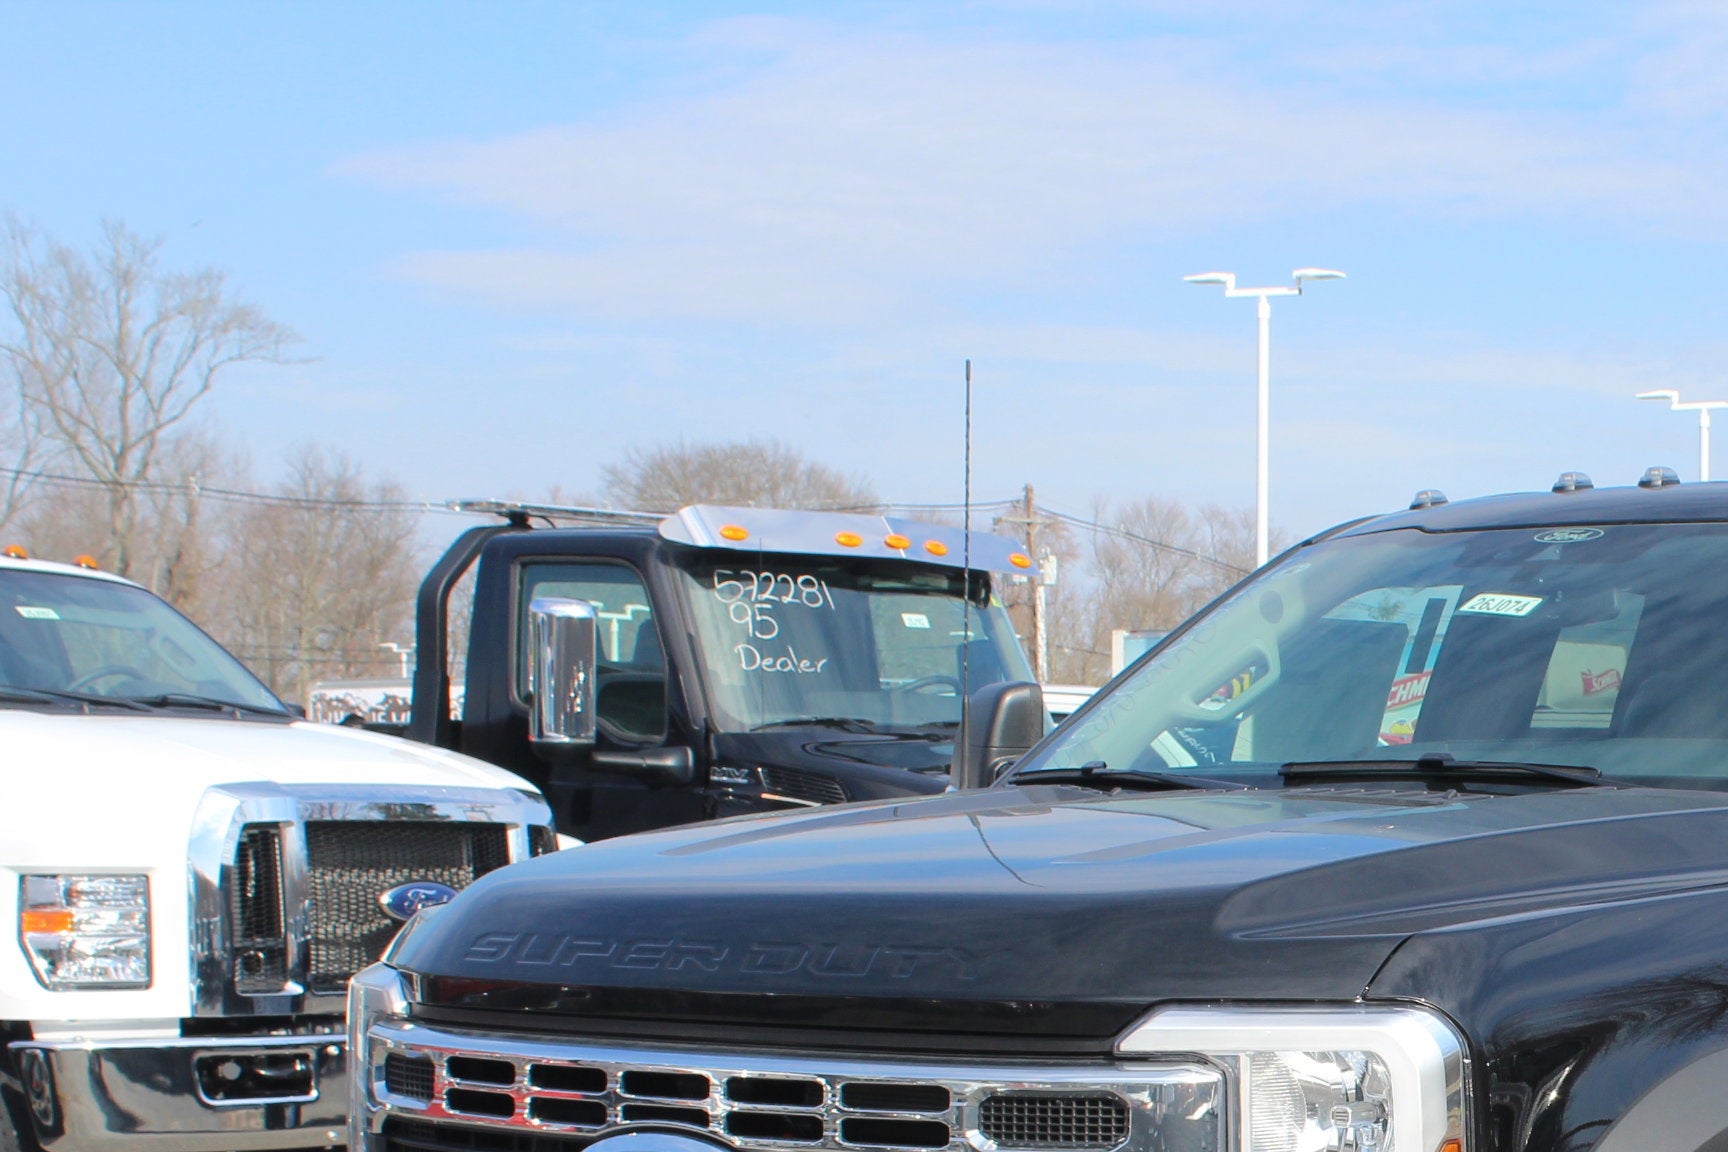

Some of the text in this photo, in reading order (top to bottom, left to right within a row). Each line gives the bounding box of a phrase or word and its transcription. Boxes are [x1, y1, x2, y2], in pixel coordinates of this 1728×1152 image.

[729, 601, 779, 639] 95
[1467, 597, 1532, 614] 26J074
[734, 643, 829, 673] Dealer
[463, 930, 988, 981] SUPER DUTY
